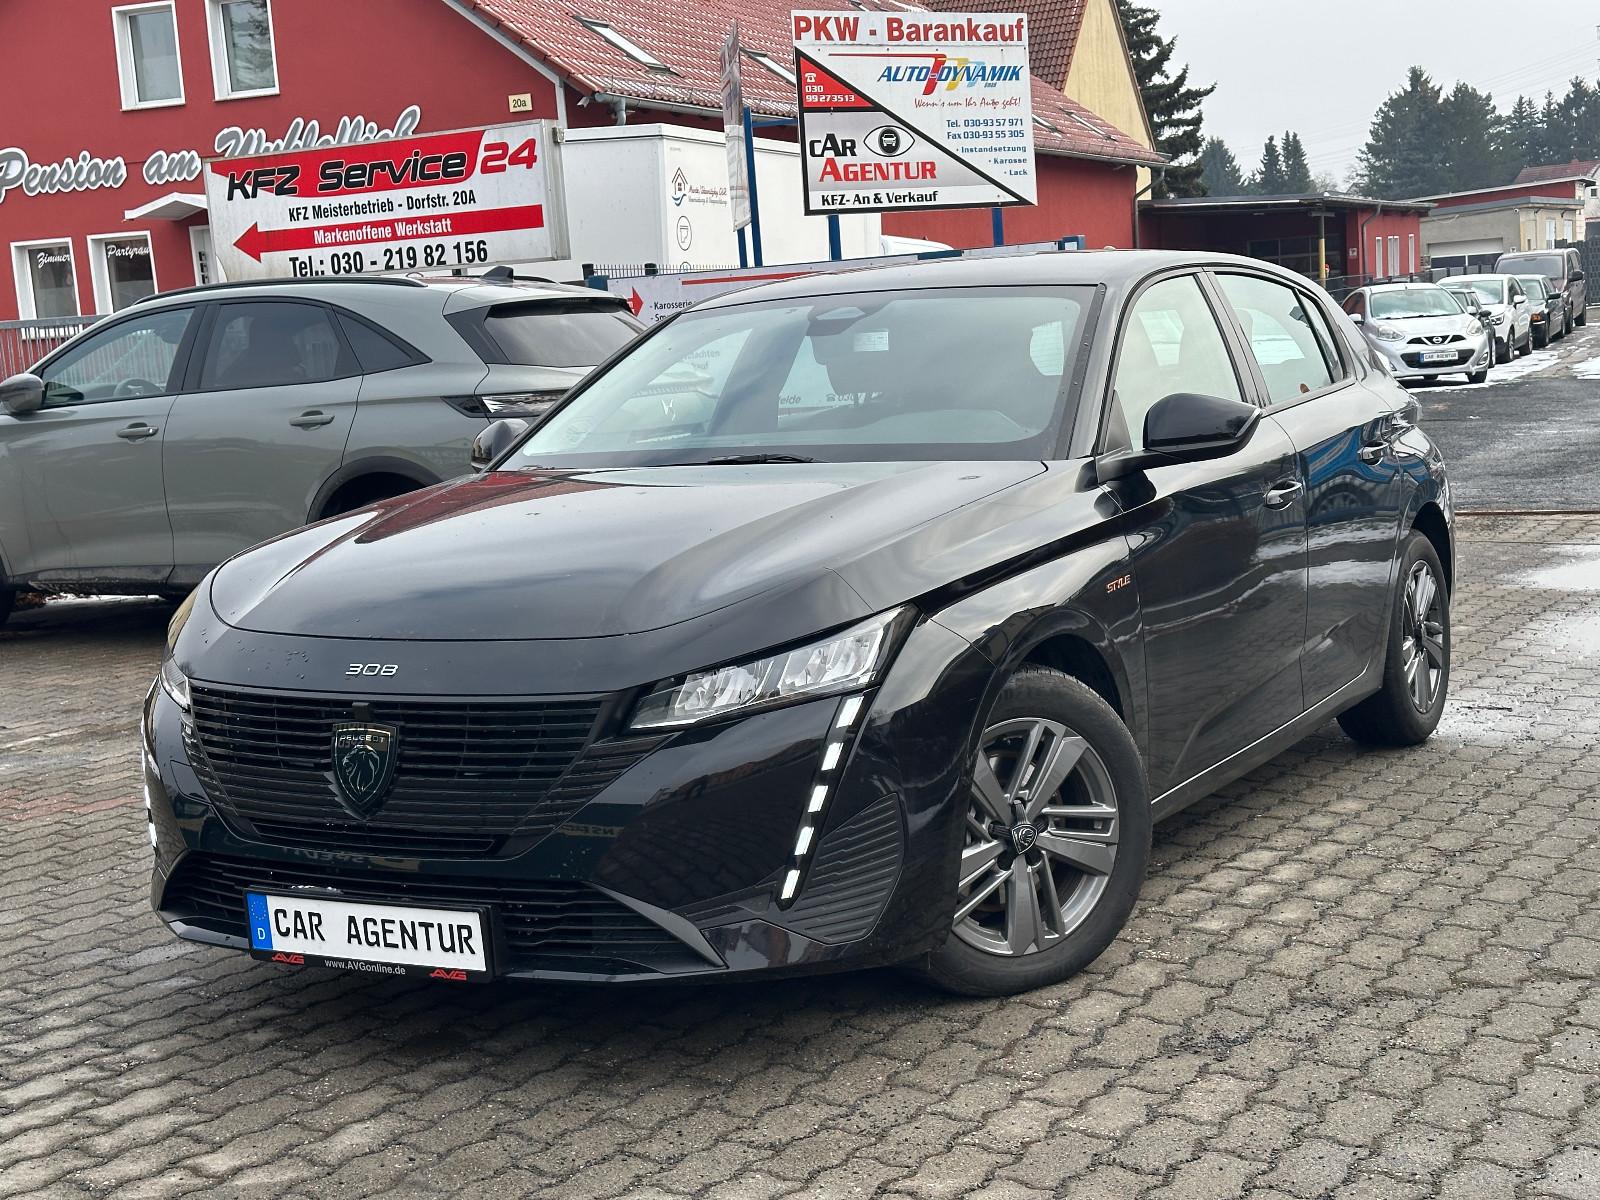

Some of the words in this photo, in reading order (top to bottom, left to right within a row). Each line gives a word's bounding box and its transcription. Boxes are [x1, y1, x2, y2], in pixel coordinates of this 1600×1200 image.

[794, 16, 859, 41] PKW
[886, 17, 1024, 42] Barankauf
[805, 85, 824, 93] 030
[512, 98, 527, 108] 20a
[914, 97, 945, 108] Wenn's
[966, 97, 977, 108] Ihr
[980, 97, 1000, 107] Auto
[1002, 97, 1021, 109] geht!
[946, 119, 961, 128] Tel.
[963, 119, 994, 128] 030-93
[995, 119, 1006, 127] 57
[1008, 118, 1023, 127] 971
[947, 131, 962, 140] Fax
[963, 131, 994, 140] 030-93
[995, 131, 1007, 139] 55
[1008, 130, 1025, 138] 305
[961, 145, 1027, 154] Instandsetzung
[0, 147, 127, 204] Pension
[143, 150, 202, 185] am
[227, 166, 301, 201] KFZ
[318, 150, 467, 191] Service
[480, 138, 539, 175] 24
[819, 158, 937, 182] AGENTUR
[288, 206, 310, 222] KFZ
[312, 198, 394, 220] Meisterbetrieb
[406, 193, 449, 211] Dorfstr.
[452, 189, 477, 206] 20A
[853, 193, 870, 205] An
[873, 193, 884, 204] &
[886, 191, 939, 203] Verkauf
[313, 224, 392, 245] Markenoffene
[394, 218, 452, 237] Werkstatt
[37, 251, 72, 268] Zimmer
[107, 244, 150, 260] Partyrau
[289, 255, 325, 278] Tel.:
[330, 250, 364, 275] 030
[383, 246, 417, 270] 219
[424, 243, 447, 267] 82
[453, 239, 488, 264] 156
[654, 299, 693, 310] Karosserie
[1107, 574, 1131, 593] STYLE
[345, 663, 398, 676] 308
[339, 734, 385, 743] PEUGEOT
[257, 927, 266, 940] D
[273, 908, 326, 941] CAR
[347, 915, 476, 955] AGENTUR
[271, 952, 305, 965] AVG
[324, 958, 406, 975] www.AVGonline.de
[429, 968, 468, 981] AVG
